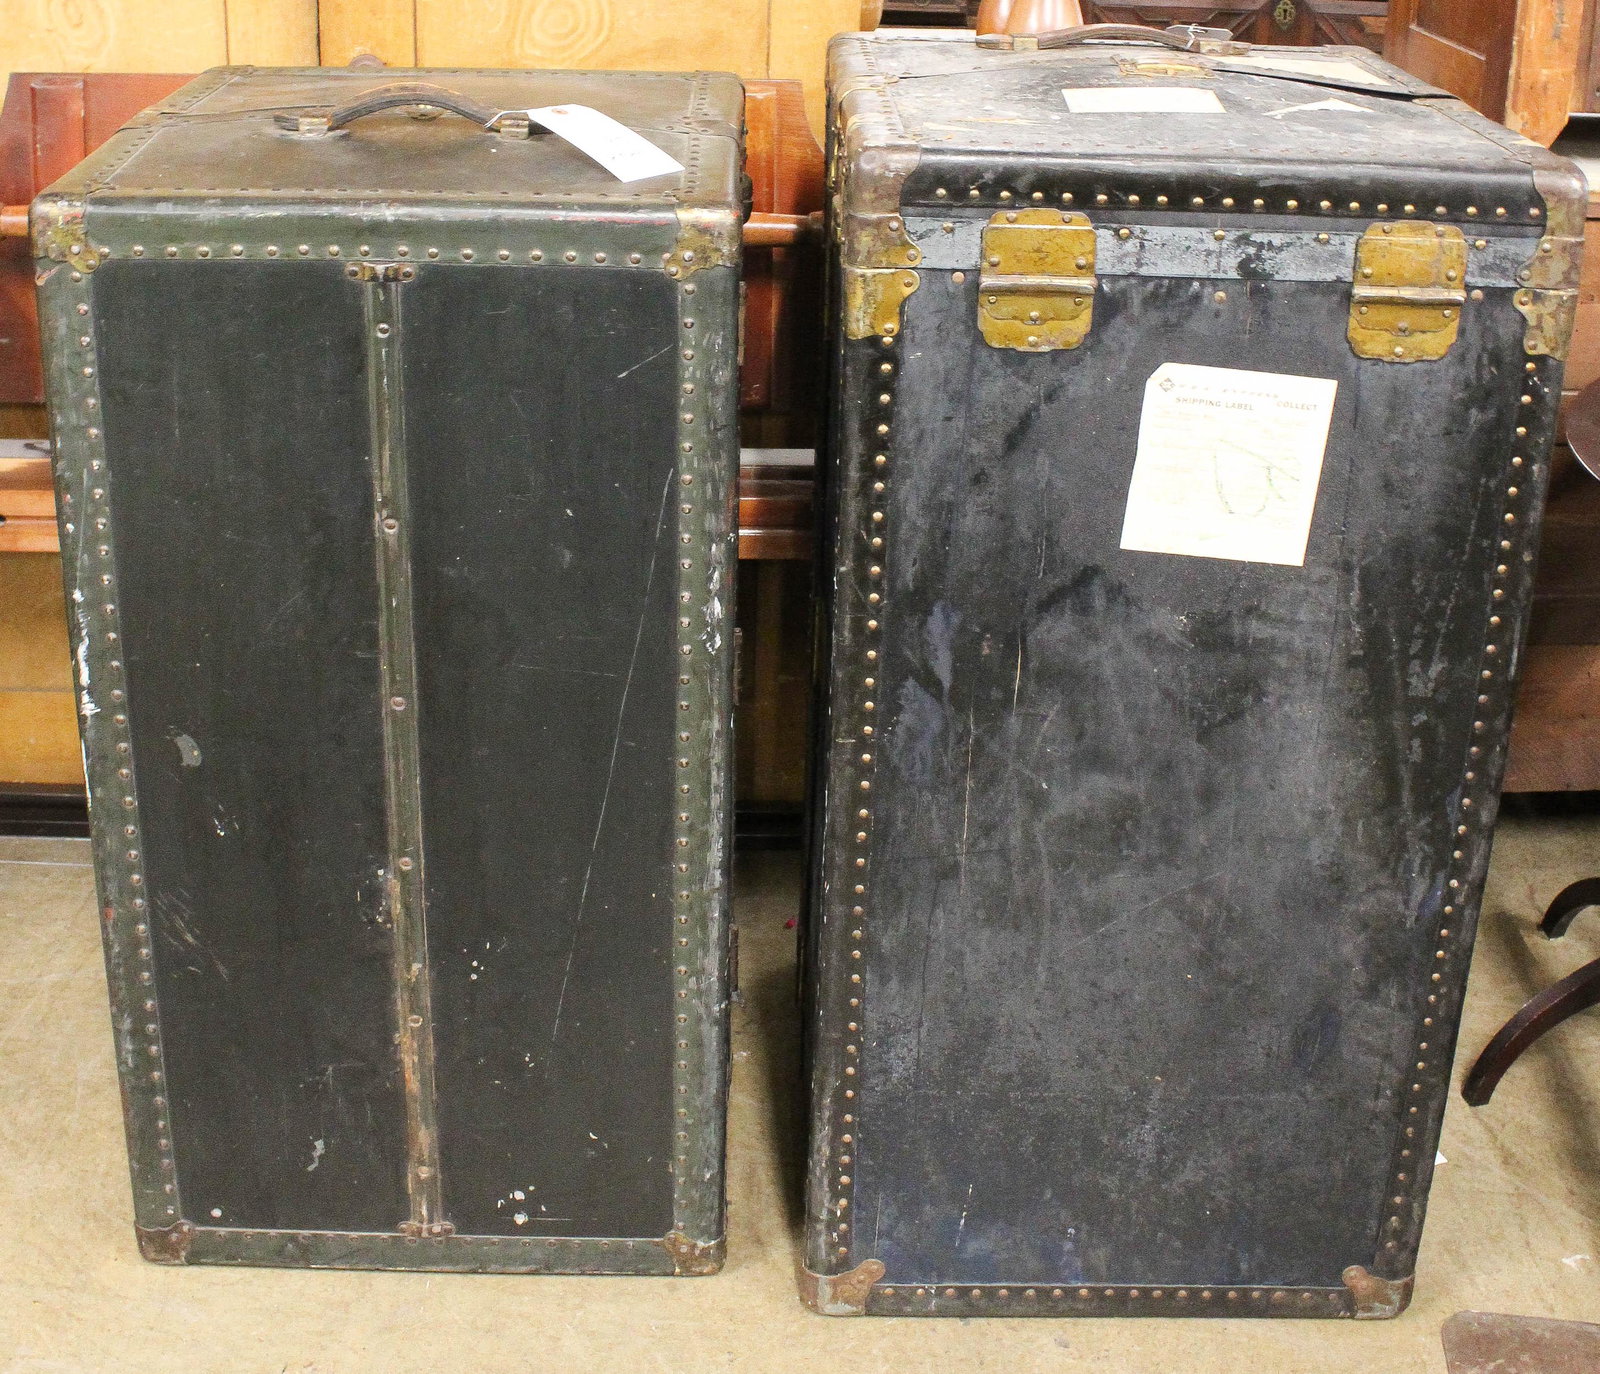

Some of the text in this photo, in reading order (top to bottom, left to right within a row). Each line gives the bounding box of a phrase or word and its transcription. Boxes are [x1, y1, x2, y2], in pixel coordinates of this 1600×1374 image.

[1175, 396, 1255, 412] SHIPPING LABEL
[1276, 400, 1318, 411] COLLECT
